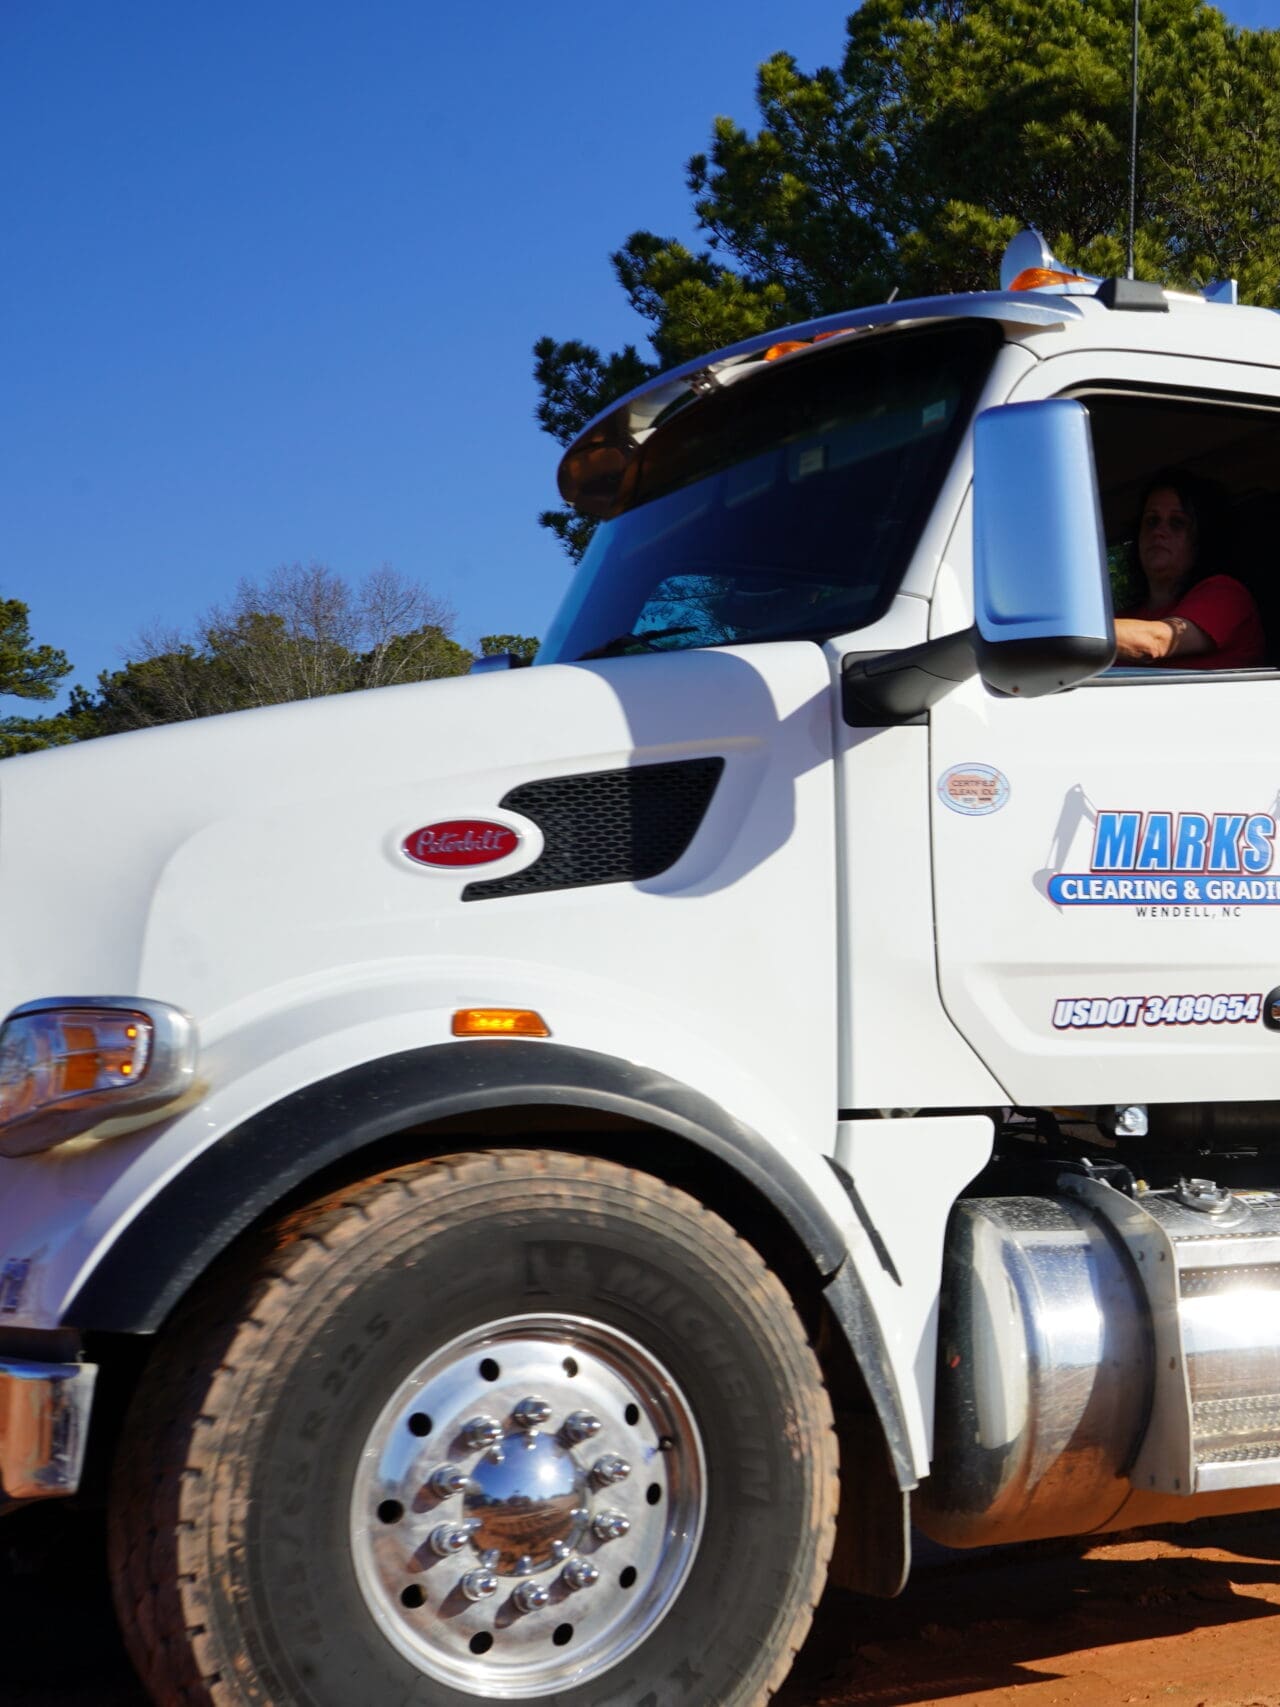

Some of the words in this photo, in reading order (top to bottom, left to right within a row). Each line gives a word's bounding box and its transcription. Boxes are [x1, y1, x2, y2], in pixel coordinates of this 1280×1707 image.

[416, 830, 510, 856] Peterbilt
[1091, 811, 1276, 874] MARKS
[1060, 879, 1178, 901] CLEARING
[1183, 880, 1201, 900] &
[1136, 906, 1217, 919] WENDELL,
[1222, 906, 1242, 918] NC
[1052, 997, 1144, 1029] USDOT
[1143, 994, 1262, 1025] 3489654
[318, 1309, 394, 1400] 22.5
[603, 1259, 773, 1505] MICHELIN
